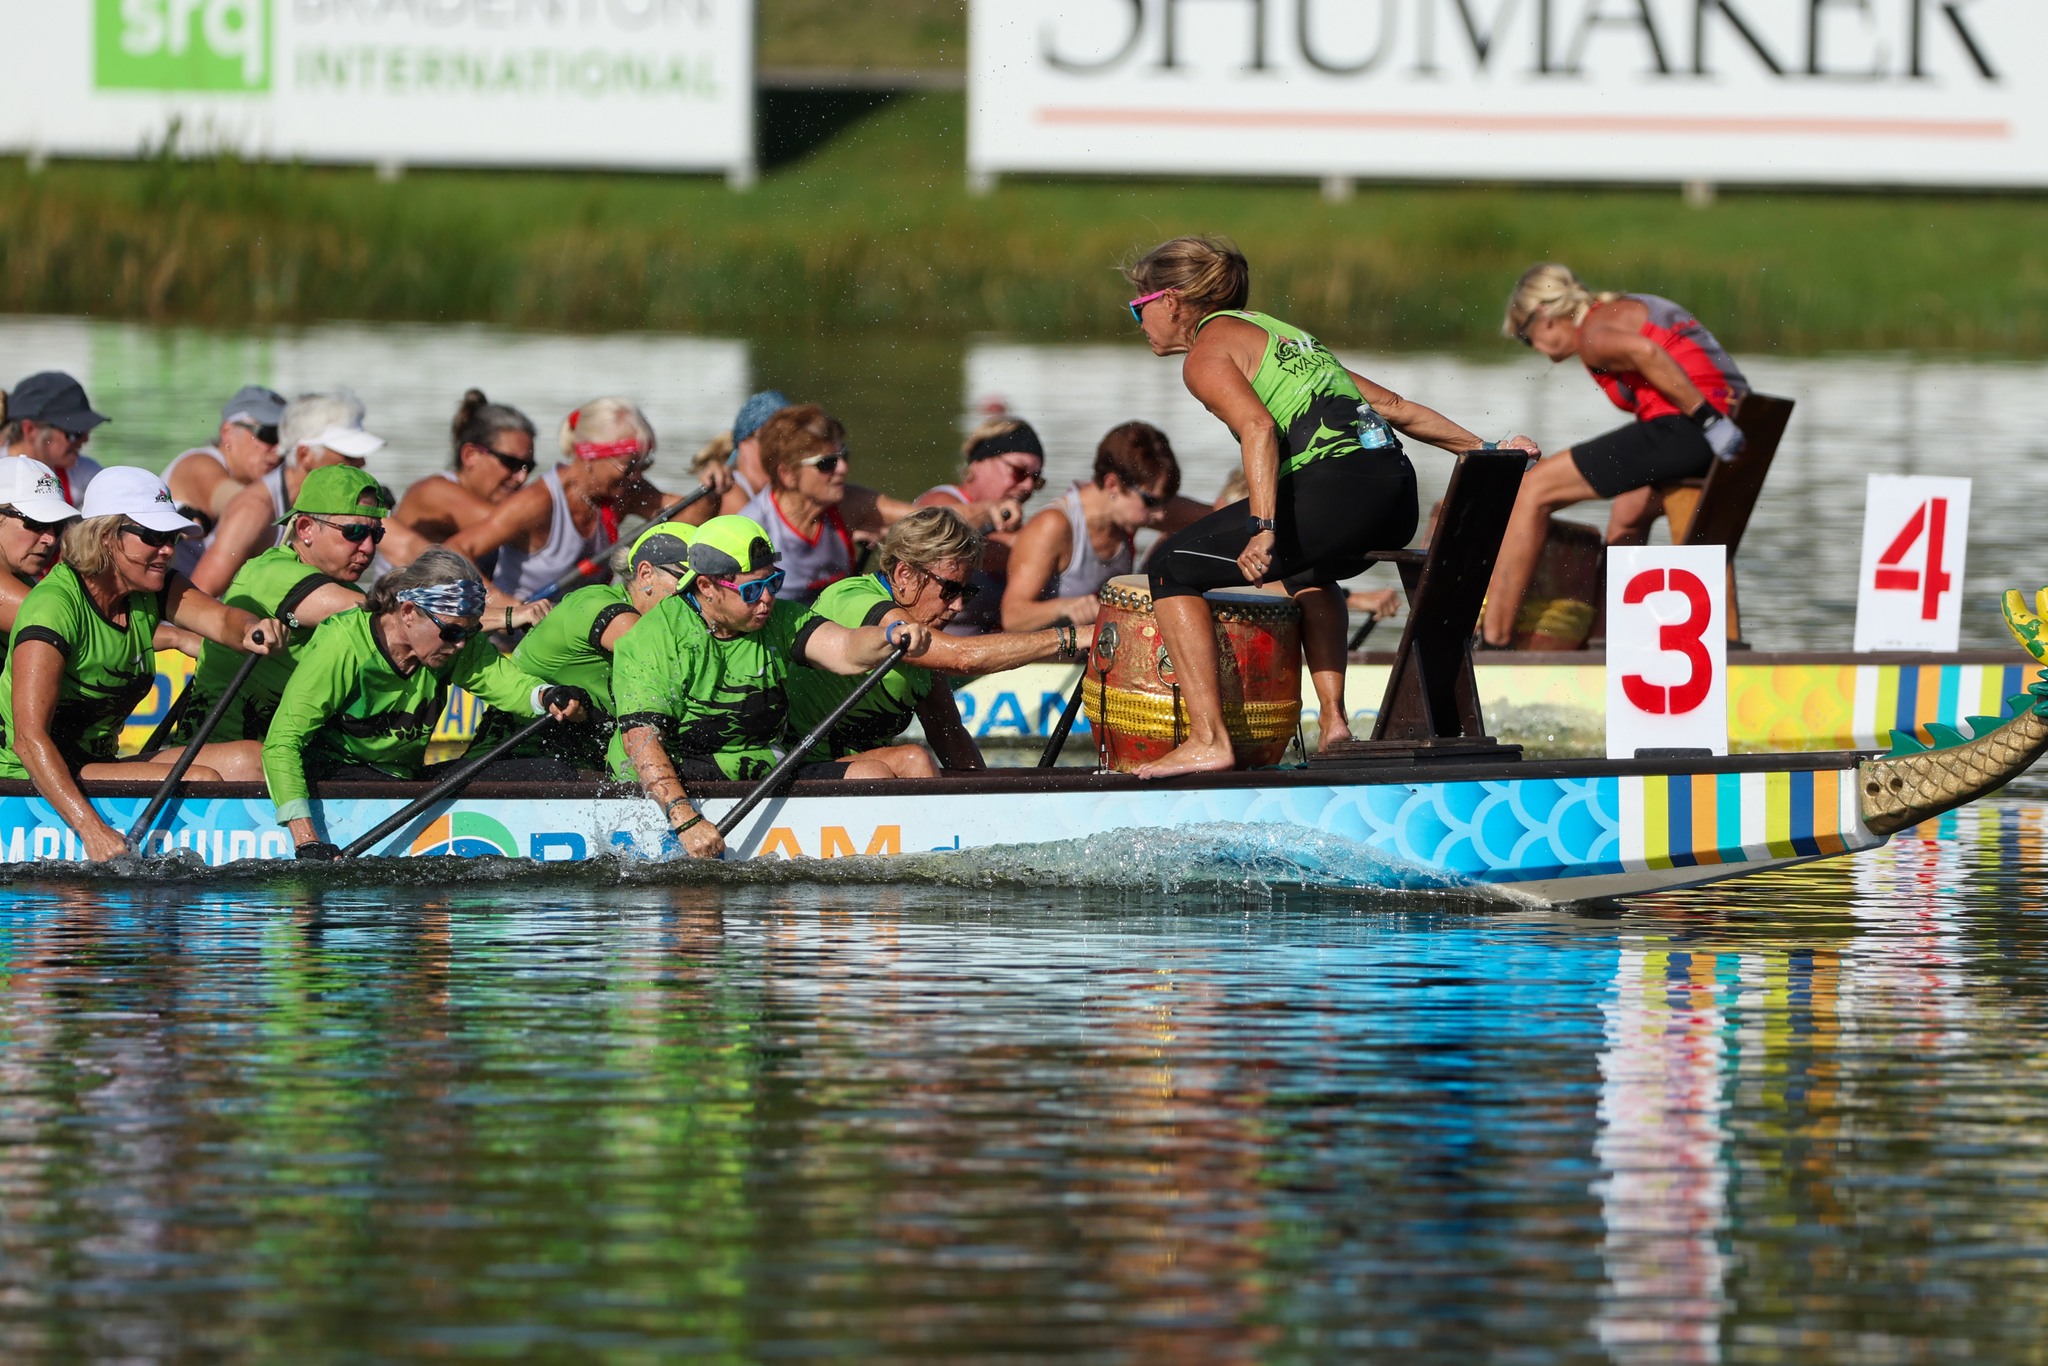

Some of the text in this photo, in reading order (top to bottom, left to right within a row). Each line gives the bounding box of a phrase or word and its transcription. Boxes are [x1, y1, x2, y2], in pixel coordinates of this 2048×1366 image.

[121, 0, 264, 87] srq
[293, 45, 723, 97] INTERNATIONAL
[1038, 0, 2001, 82] SHUMAKER
[1874, 497, 1951, 620] 4
[1621, 567, 1713, 715] 3
